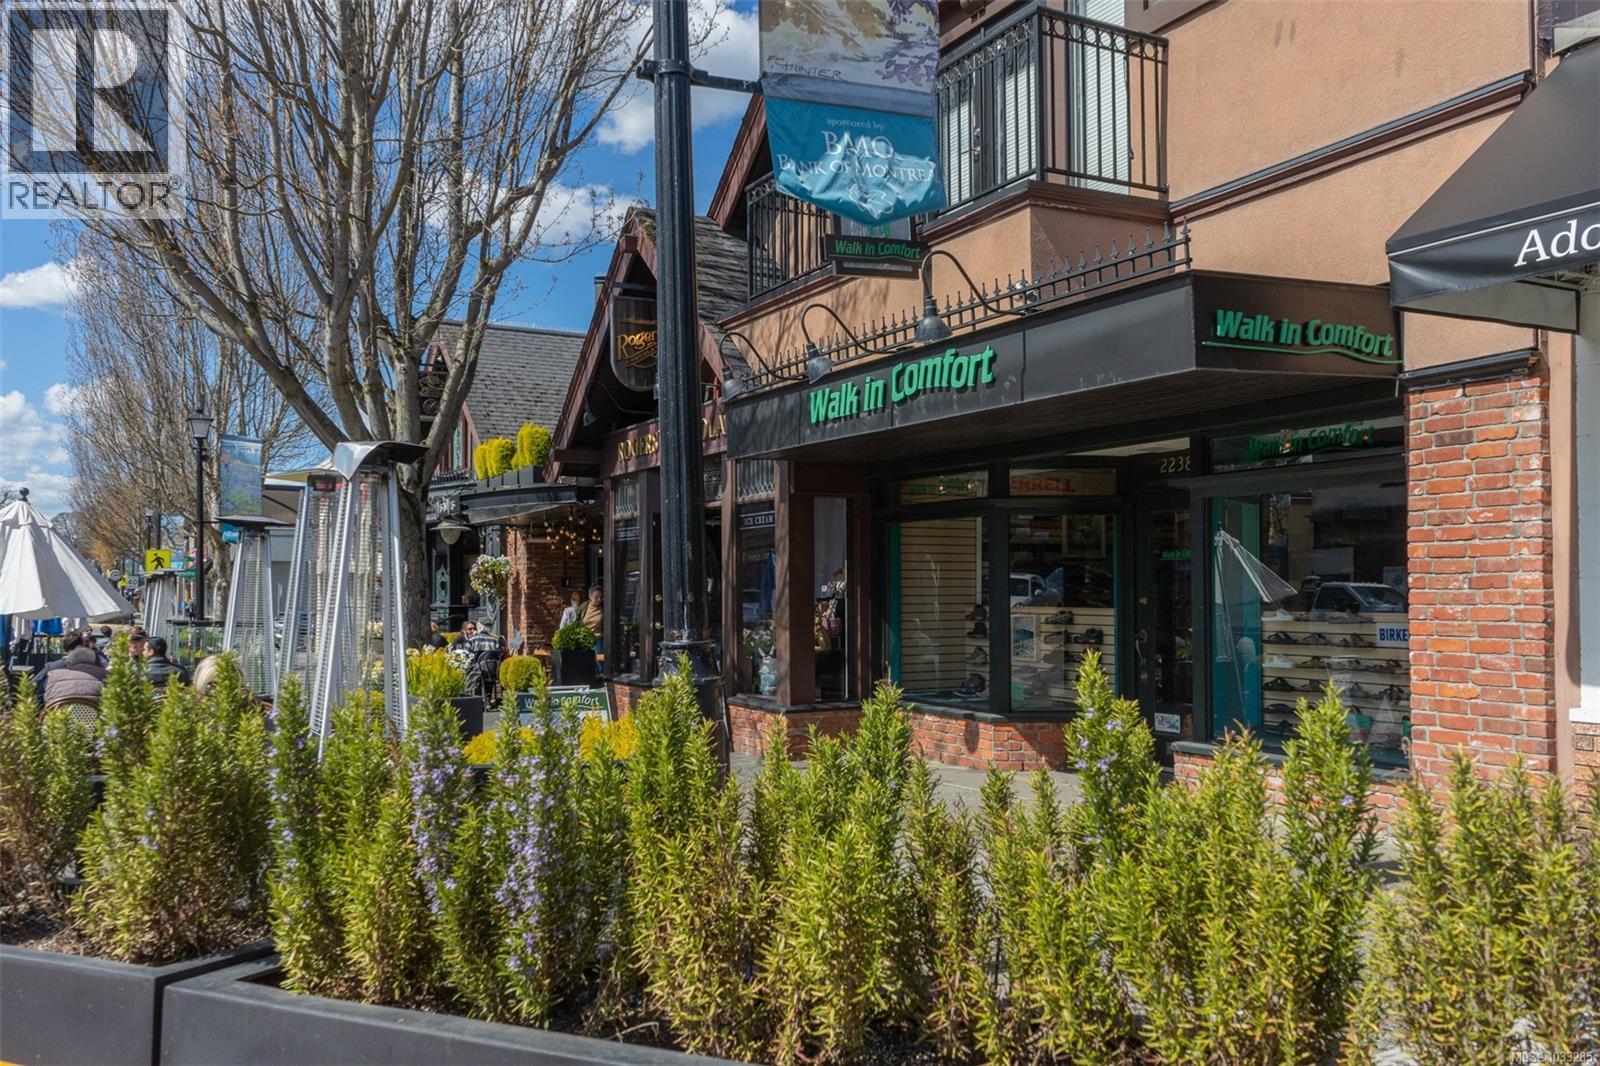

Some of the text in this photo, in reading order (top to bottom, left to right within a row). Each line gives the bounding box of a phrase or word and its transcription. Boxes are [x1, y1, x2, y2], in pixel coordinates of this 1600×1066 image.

[872, 120, 885, 132] by
[821, 130, 894, 159] BMO
[777, 153, 936, 182] BANK OF MONTREA
[835, 239, 921, 259] Walk in Comfort
[616, 330, 657, 360] Roger
[1216, 309, 1394, 357] Walk in Comfort
[809, 345, 996, 424] Walk in Comfort
[1308, 424, 1376, 450] Comfort
[1160, 455, 1191, 473] 2238
[1379, 628, 1409, 642] BIRKE
